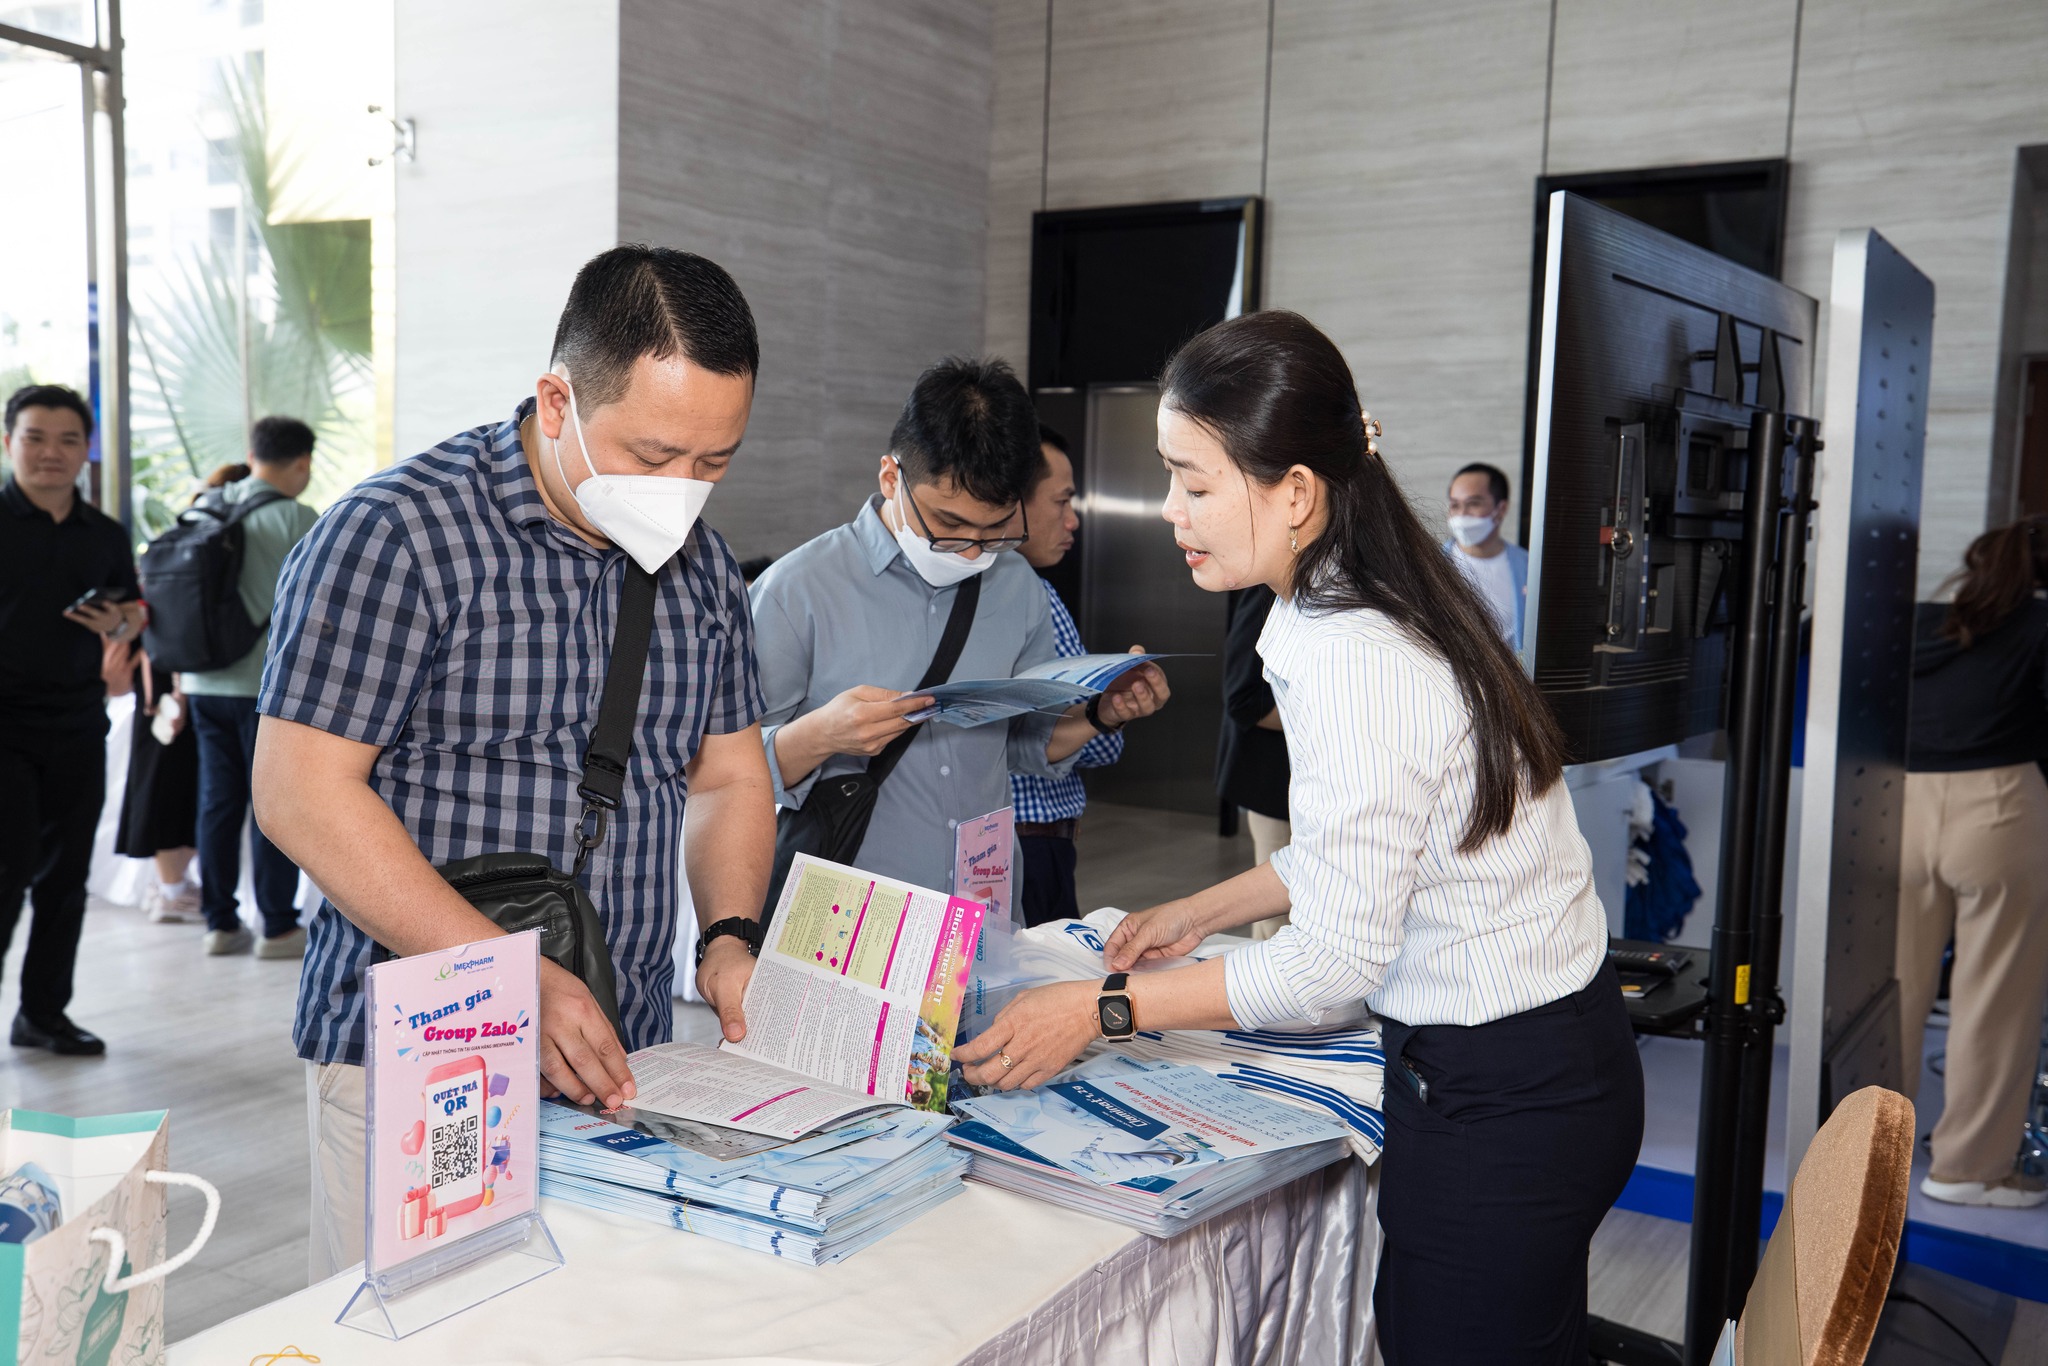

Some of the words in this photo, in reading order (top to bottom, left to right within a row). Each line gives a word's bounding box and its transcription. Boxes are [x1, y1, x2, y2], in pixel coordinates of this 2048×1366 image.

[968, 850, 986, 867] Tham
[972, 865, 991, 878] Group
[991, 865, 1005, 876] Zalo
[453, 956, 494, 971] IMEXPHARM
[933, 984, 944, 1006] DT
[409, 1001, 460, 1029] Tham
[465, 989, 492, 1011] gia
[423, 1026, 477, 1043] Group
[481, 1021, 517, 1038] Zalo
[433, 1087, 460, 1104] QUÉT
[444, 1095, 468, 1116] QR
